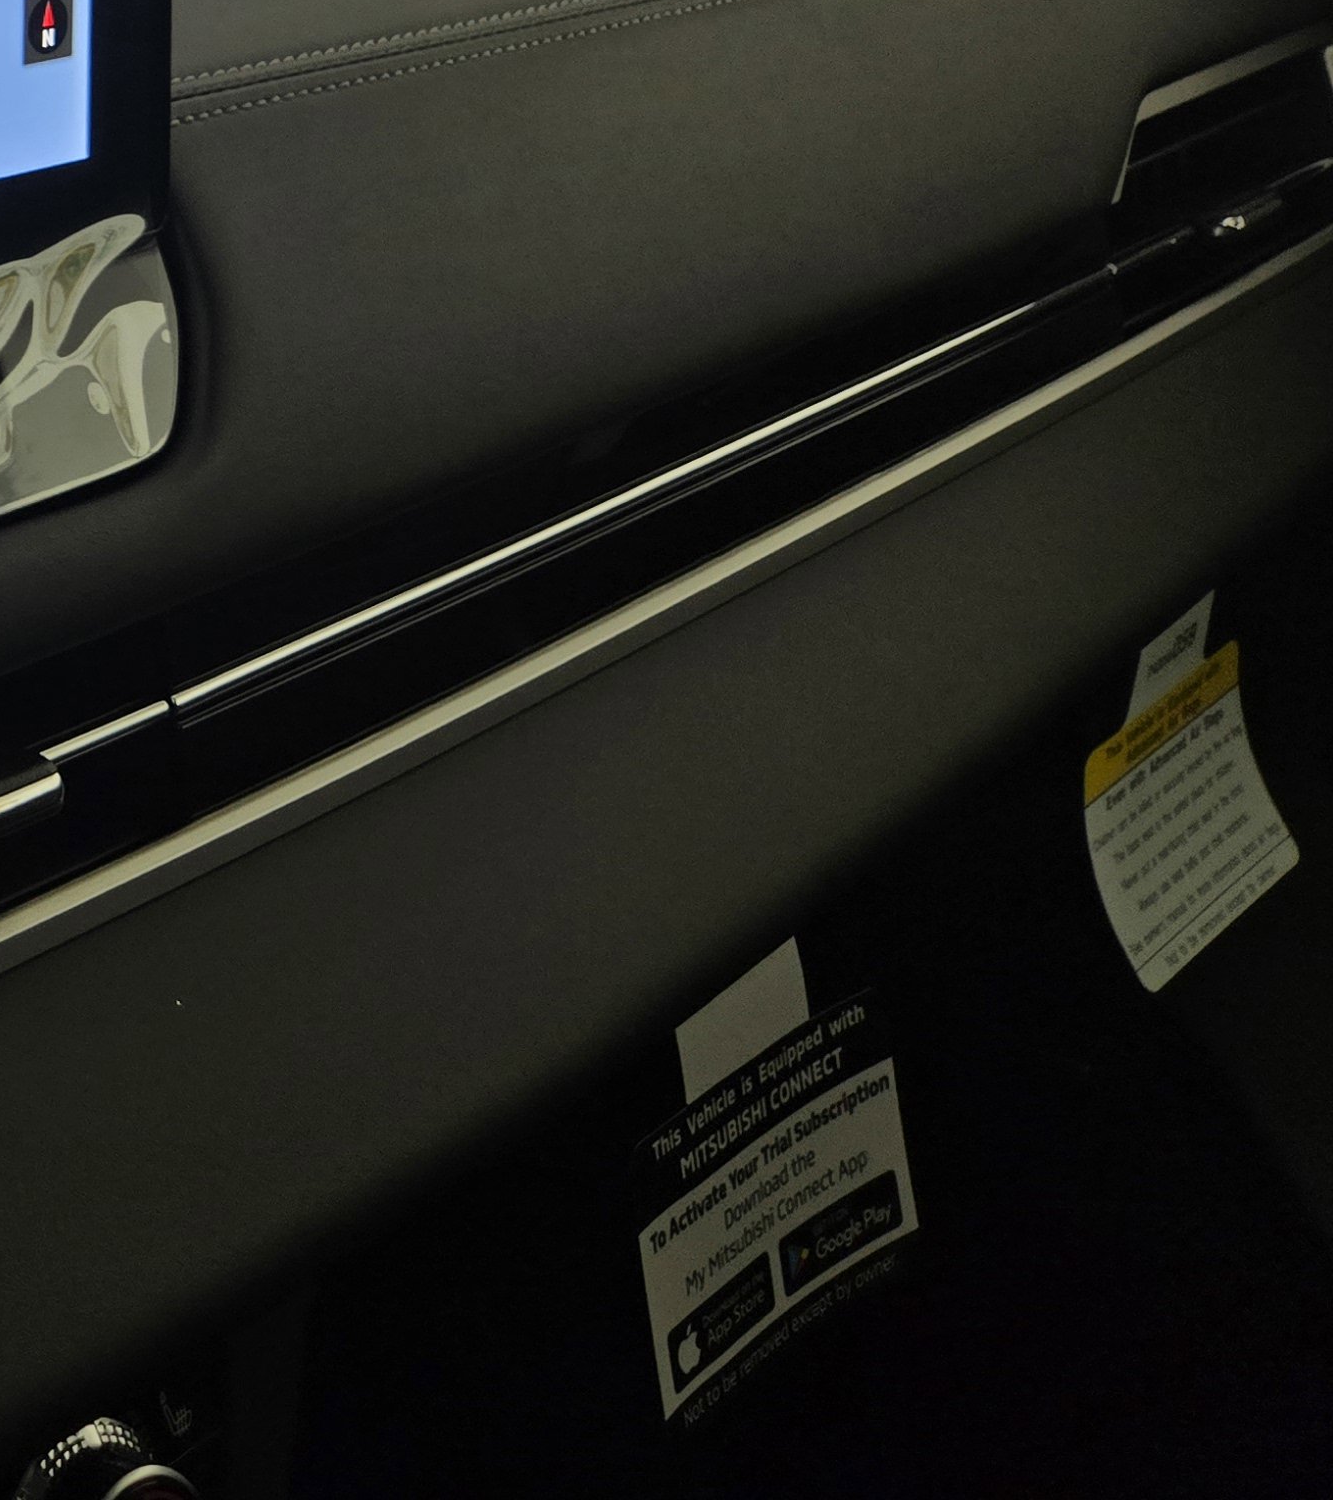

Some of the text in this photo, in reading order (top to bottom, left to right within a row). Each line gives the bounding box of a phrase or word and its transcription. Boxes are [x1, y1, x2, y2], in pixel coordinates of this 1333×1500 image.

[41, 27, 55, 48] N
[652, 1005, 865, 1161] This Vehicle is Equipped with
[680, 1047, 843, 1179] MITSUBISHI CONNECT
[649, 1073, 890, 1255] To Activate Your Trial Subscription
[724, 1175, 788, 1230] Download
[791, 1148, 815, 1175] the
[685, 1270, 707, 1297] My
[708, 1210, 775, 1276] Mitsubishi
[778, 1169, 835, 1222] Connect
[839, 1151, 869, 1181] App
[815, 1220, 862, 1261] Google
[864, 1202, 892, 1233] Play
[707, 1288, 766, 1347] App Store
